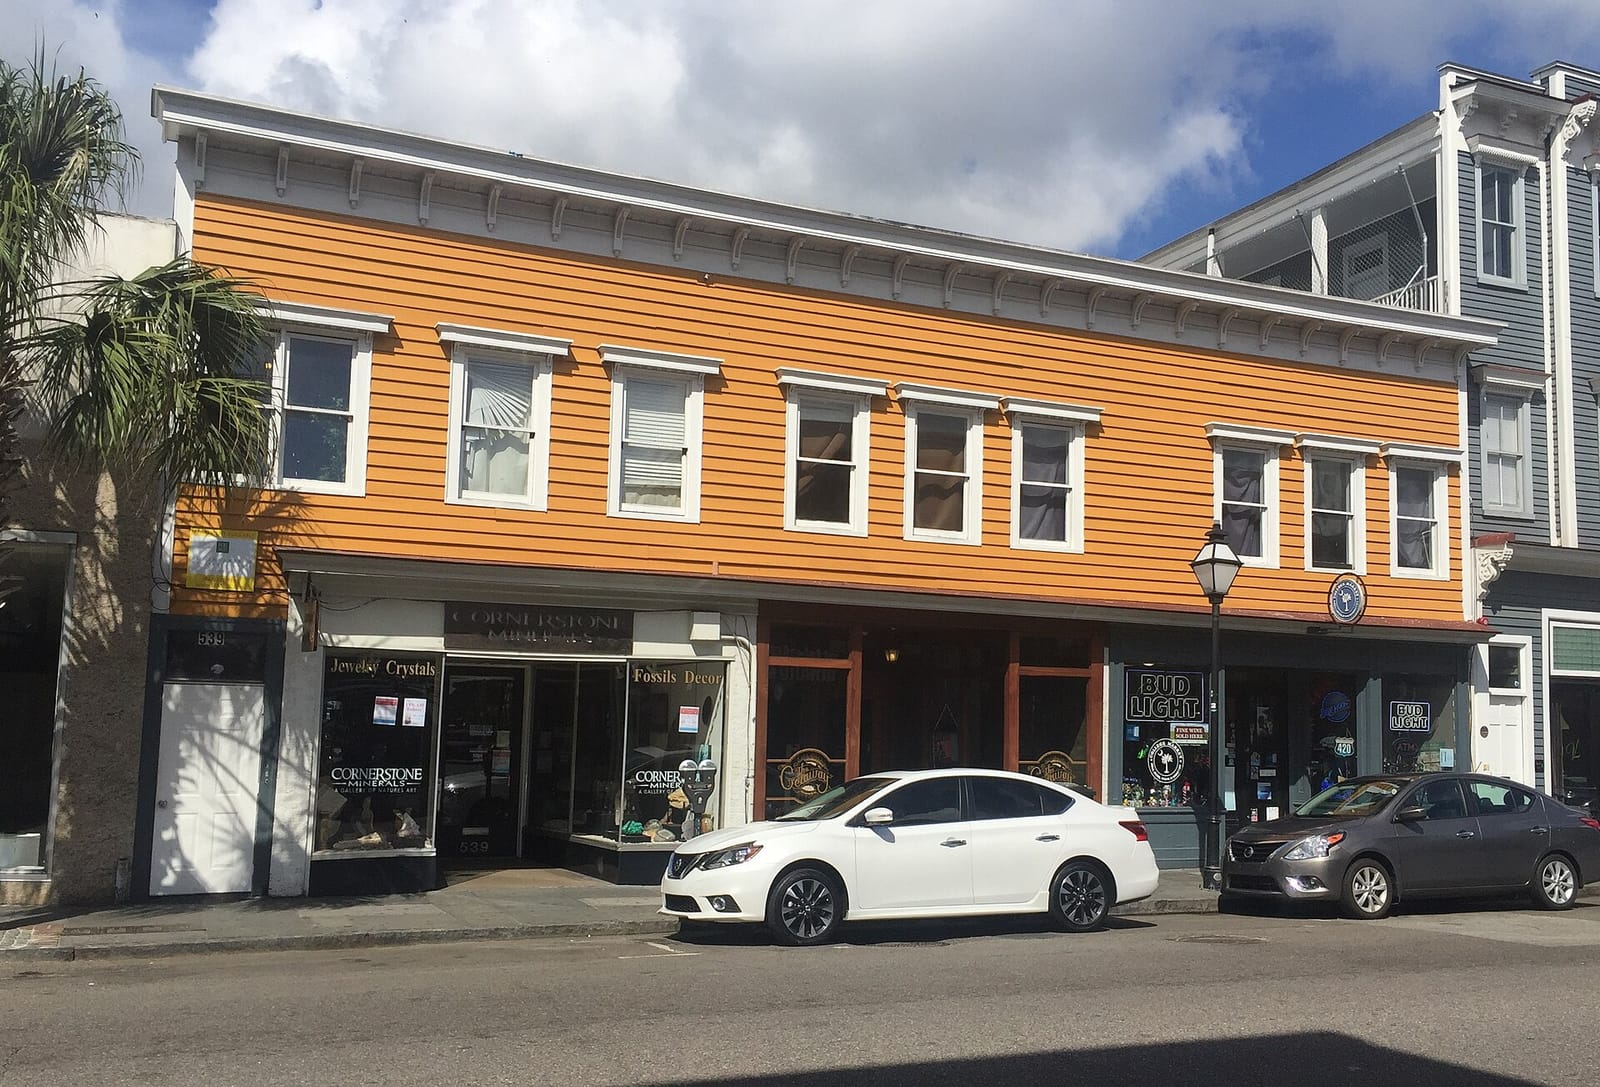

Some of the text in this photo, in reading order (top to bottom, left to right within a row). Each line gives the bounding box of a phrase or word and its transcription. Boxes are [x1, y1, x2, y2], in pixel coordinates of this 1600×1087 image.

[199, 632, 225, 645] 539
[331, 658, 436, 679] Jewelry Crystals
[633, 668, 722, 685] Fossils Decor
[1140, 674, 1191, 697] BUD
[1130, 696, 1199, 718] LIGHT
[1397, 704, 1423, 716] BUD
[1392, 716, 1427, 728] LIGHT
[1337, 743, 1352, 754] 420
[331, 768, 423, 781] CORNERSTONE
[635, 770, 682, 783] CORNER
[459, 841, 489, 853] 539
